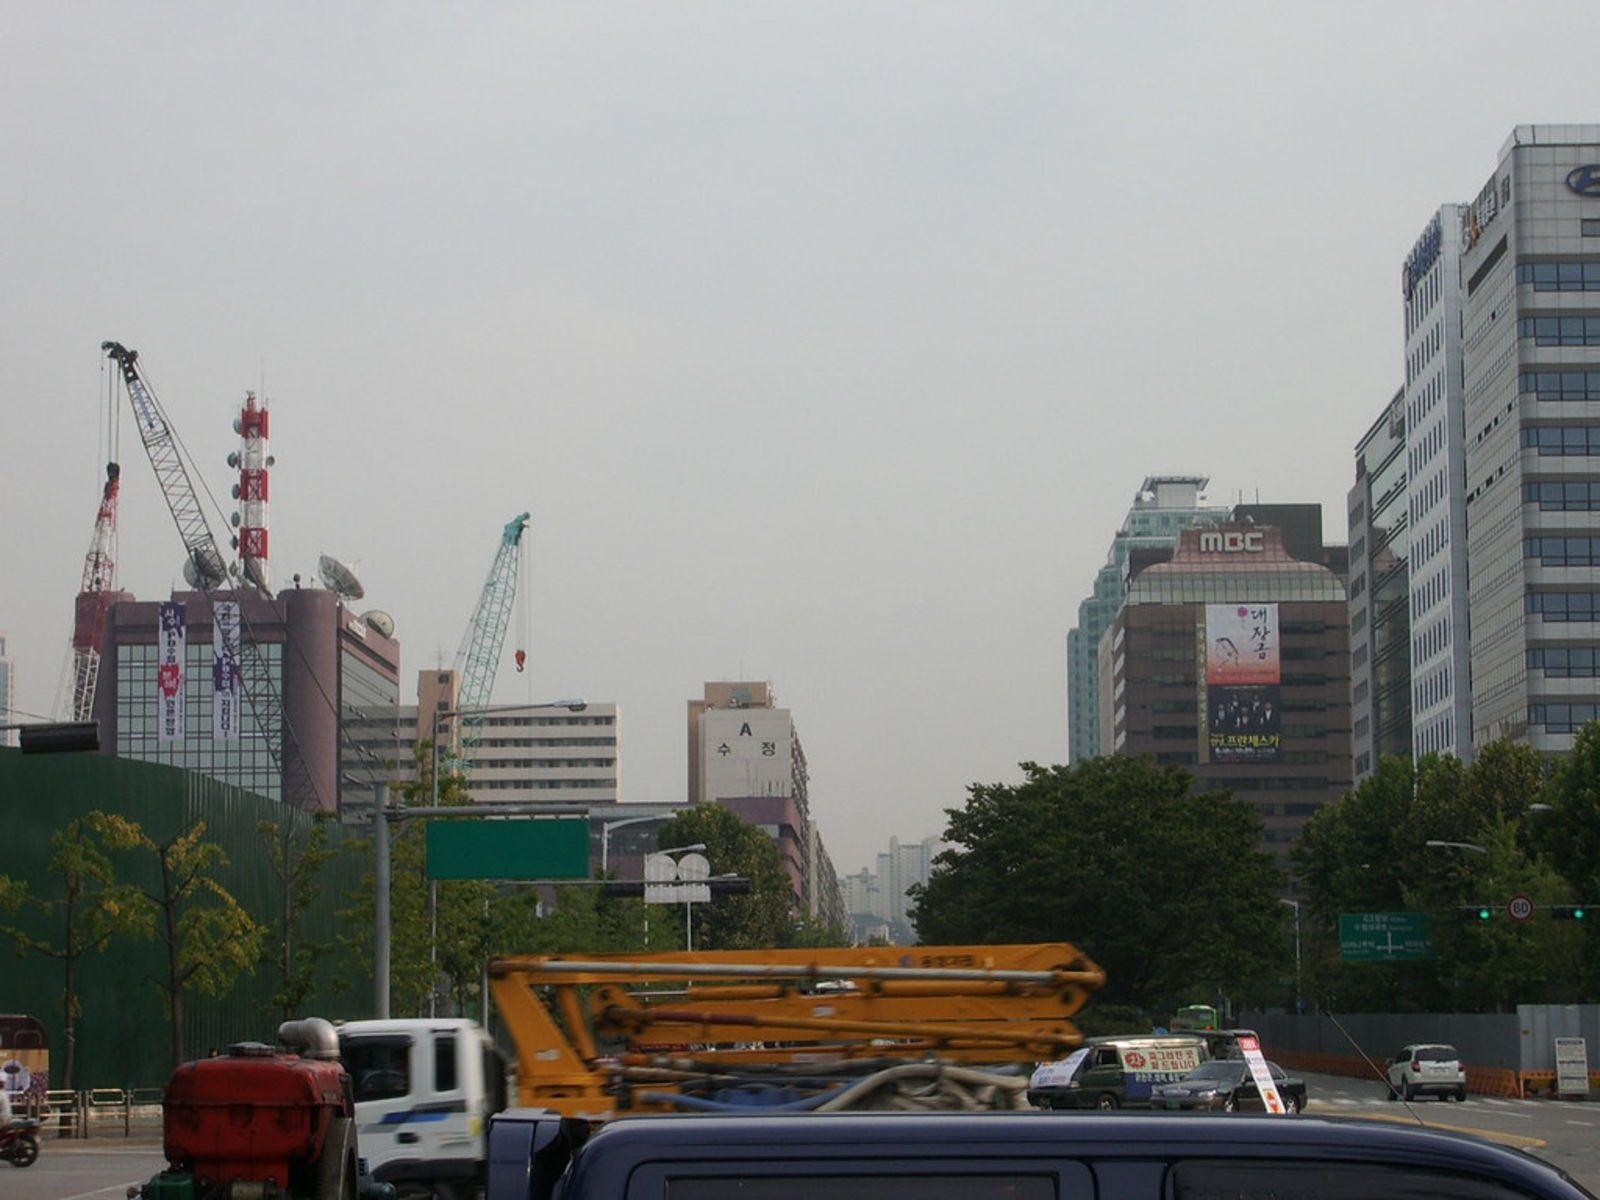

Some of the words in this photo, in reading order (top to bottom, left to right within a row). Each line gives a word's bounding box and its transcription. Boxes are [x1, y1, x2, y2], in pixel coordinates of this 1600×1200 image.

[1200, 532, 1264, 552] MBC
[1250, 607, 1272, 660] 대장금
[739, 722, 752, 737] A
[1513, 902, 1529, 914] 60
